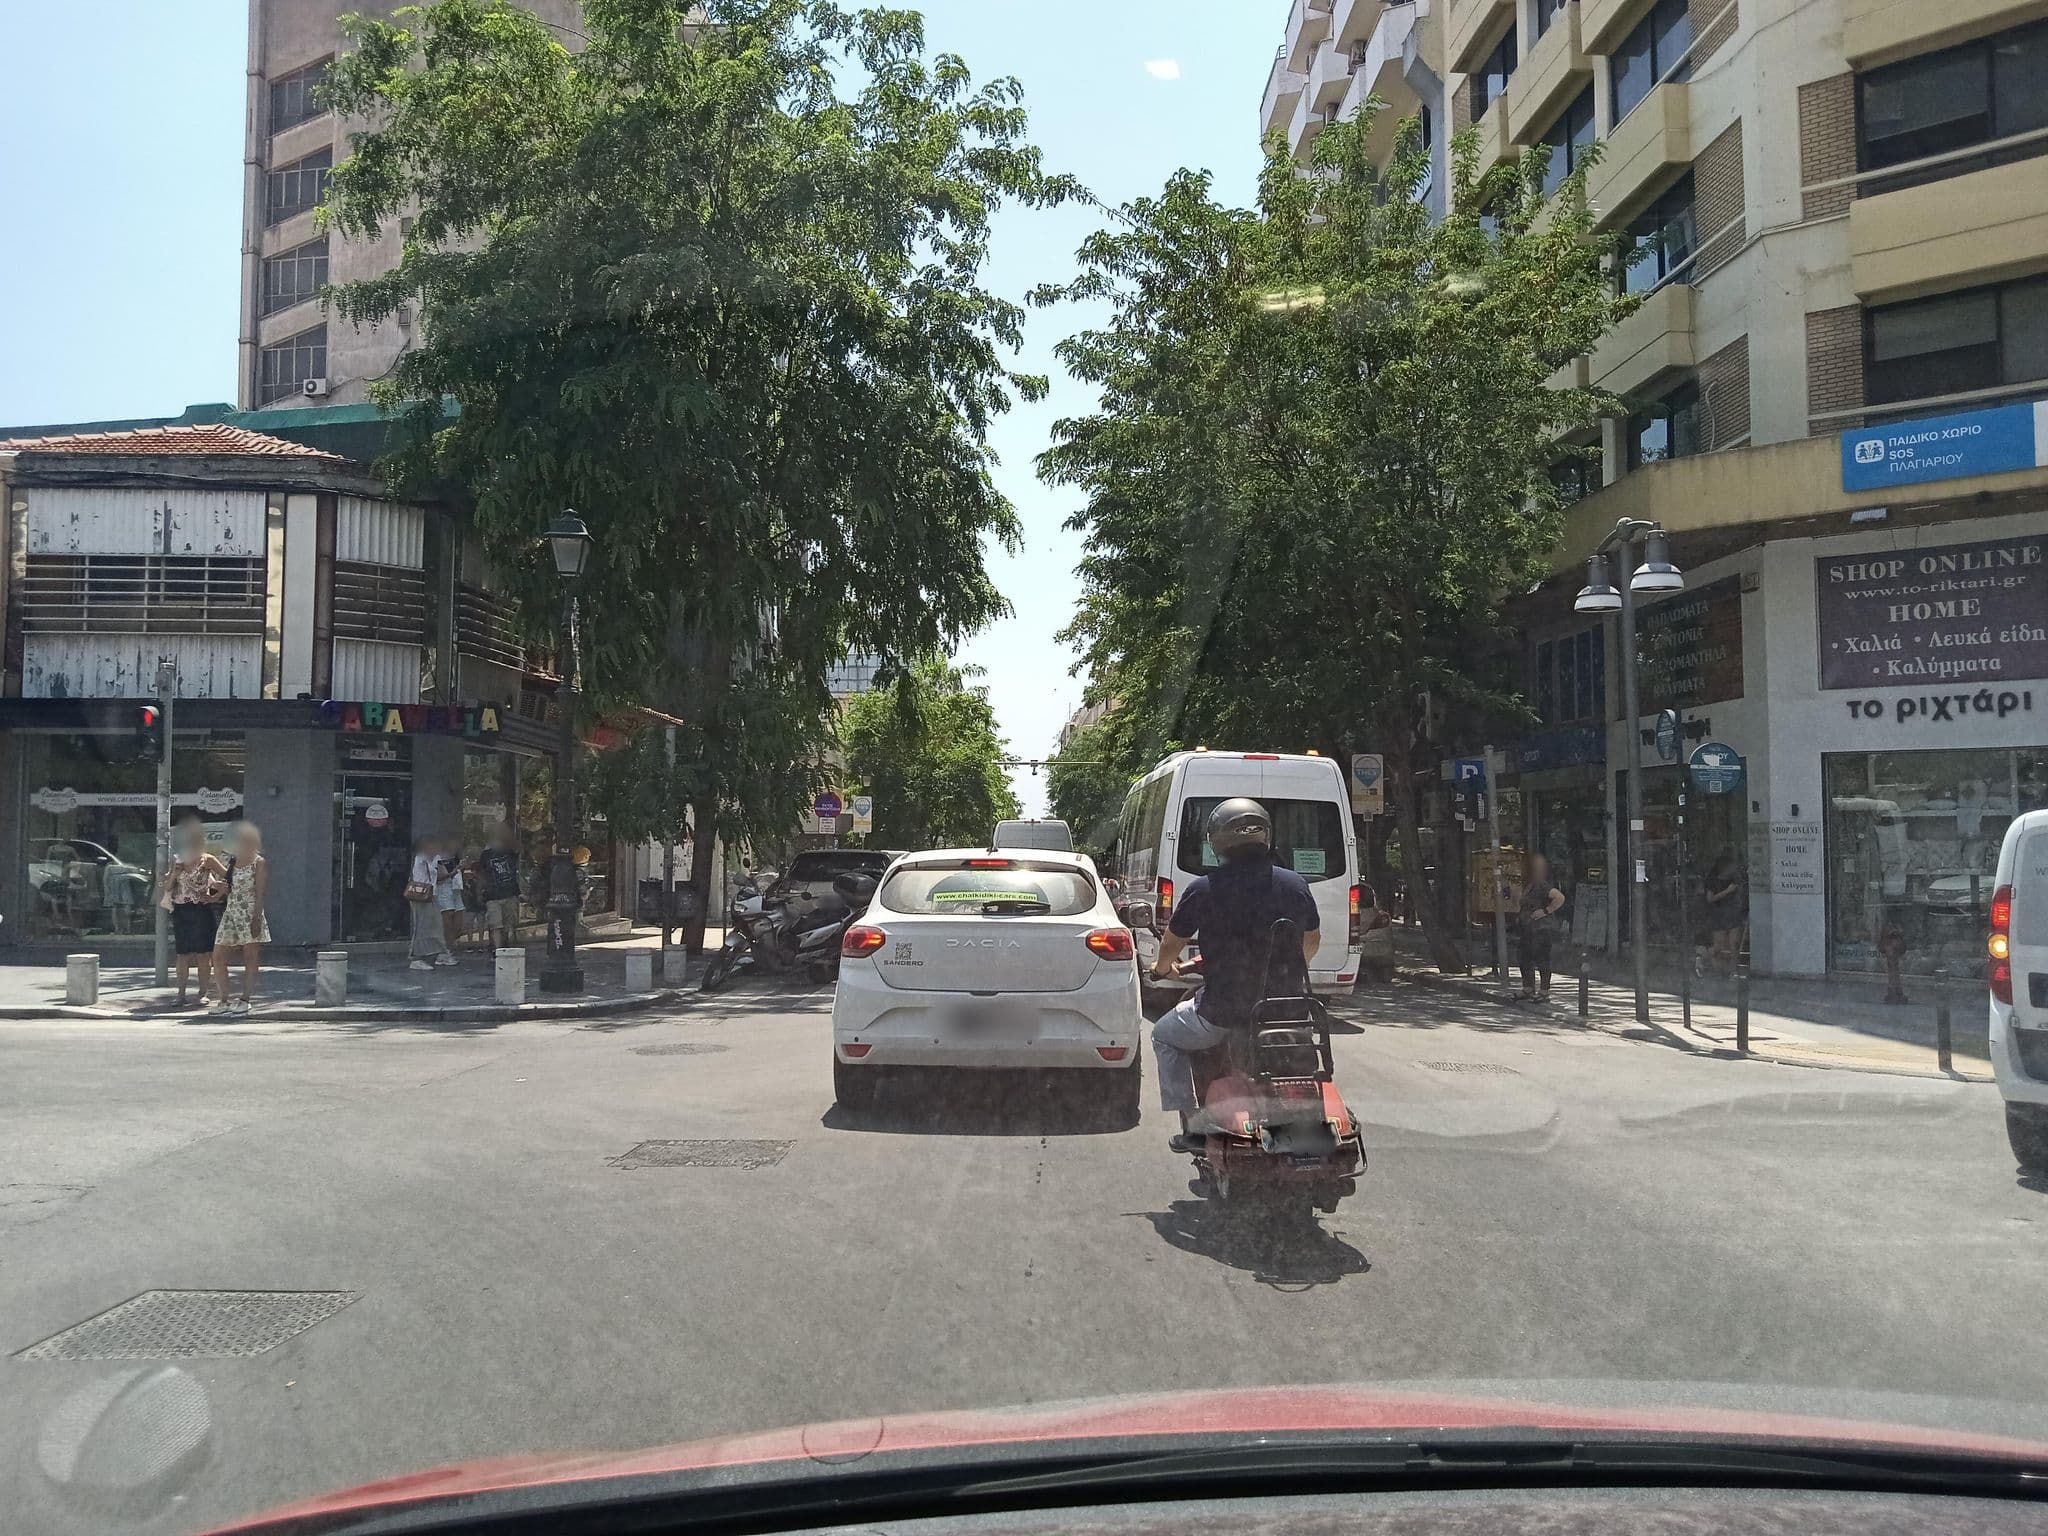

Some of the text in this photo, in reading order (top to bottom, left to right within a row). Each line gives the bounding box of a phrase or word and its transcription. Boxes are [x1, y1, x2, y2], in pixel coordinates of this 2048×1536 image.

[1888, 425, 1982, 447] ΠΑΙΔΙΚΟ ΧΩΡΙΟ
[1889, 448, 1914, 460] SOS
[1890, 452, 1963, 472] ΠΛΑΓΙΑΡΙΟΥ
[1830, 545, 2042, 583] SHOP ONLINE
[1844, 576, 2026, 599] www.to-riktari.gr
[1888, 598, 1981, 622] HOME
[1845, 623, 2047, 654] Χαλιά Λευκά είδη
[1887, 656, 2001, 678] Καλύμματα
[1897, 688, 2032, 723] ριχτάρι
[936, 891, 1037, 900] www.chalkidiki-cars.com
[946, 938, 1020, 948] DACIA
